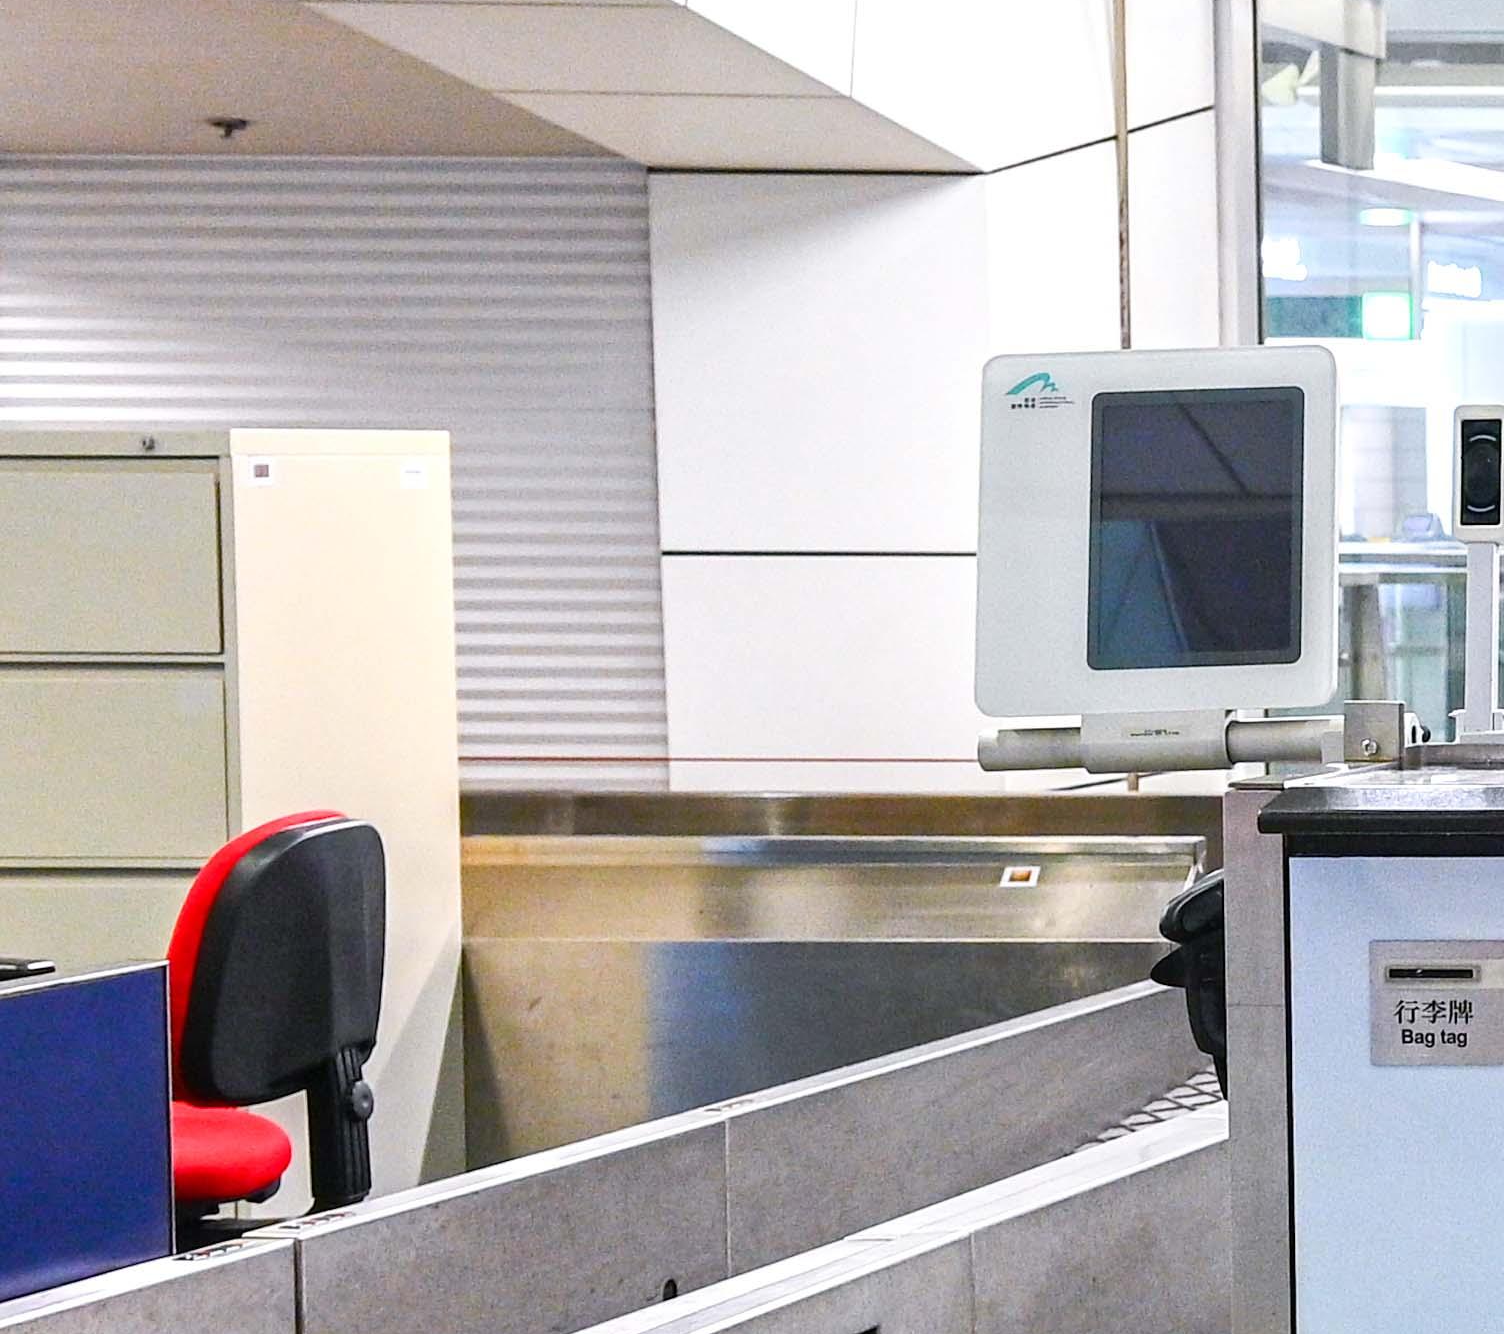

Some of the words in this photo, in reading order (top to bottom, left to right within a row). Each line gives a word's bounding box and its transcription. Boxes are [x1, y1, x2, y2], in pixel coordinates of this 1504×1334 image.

[1393, 999, 1474, 1025] 行李牌
[1401, 1028, 1436, 1048] Bag
[1440, 1029, 1468, 1048] tag
